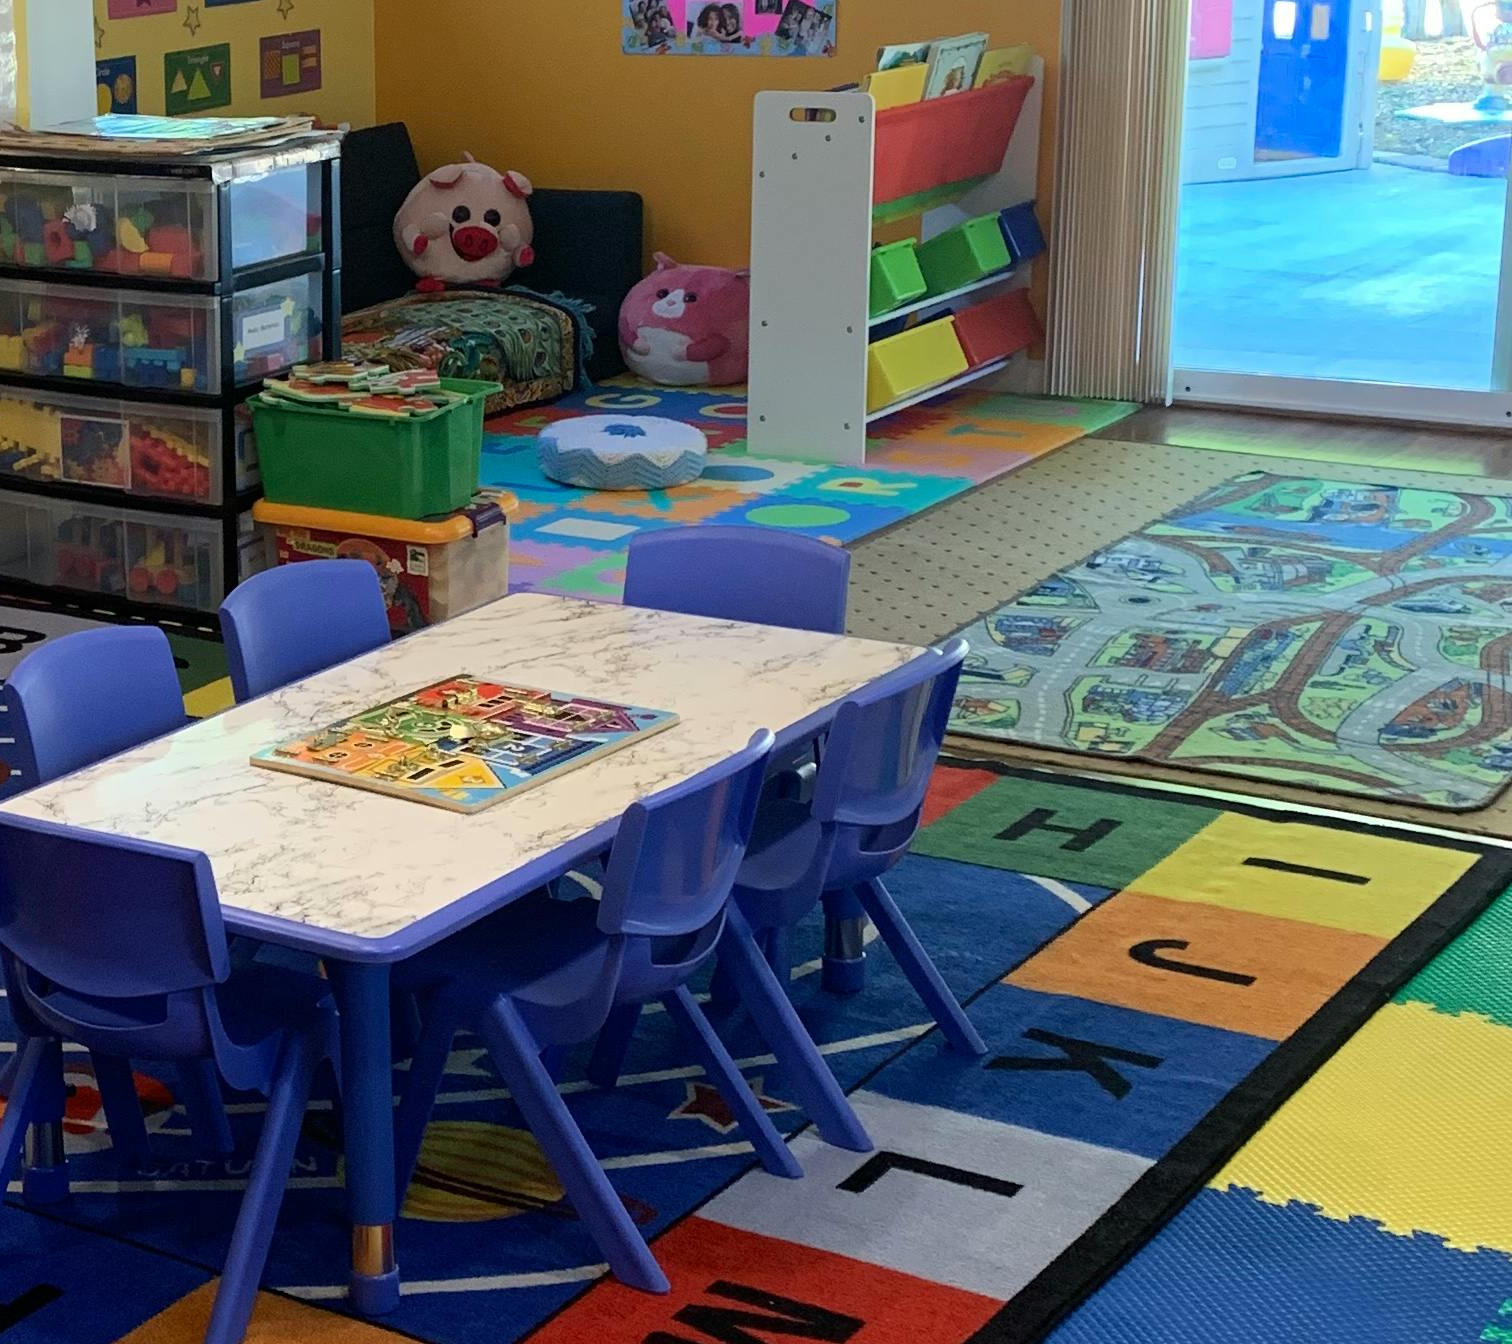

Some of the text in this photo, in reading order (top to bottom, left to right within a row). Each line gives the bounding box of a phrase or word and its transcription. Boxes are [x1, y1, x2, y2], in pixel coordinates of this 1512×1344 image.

[993, 808, 1122, 852] H
[1242, 857, 1370, 885] I
[1129, 939, 1256, 986] J
[983, 1028, 1163, 1100] K
[836, 1151, 1023, 1197] L
